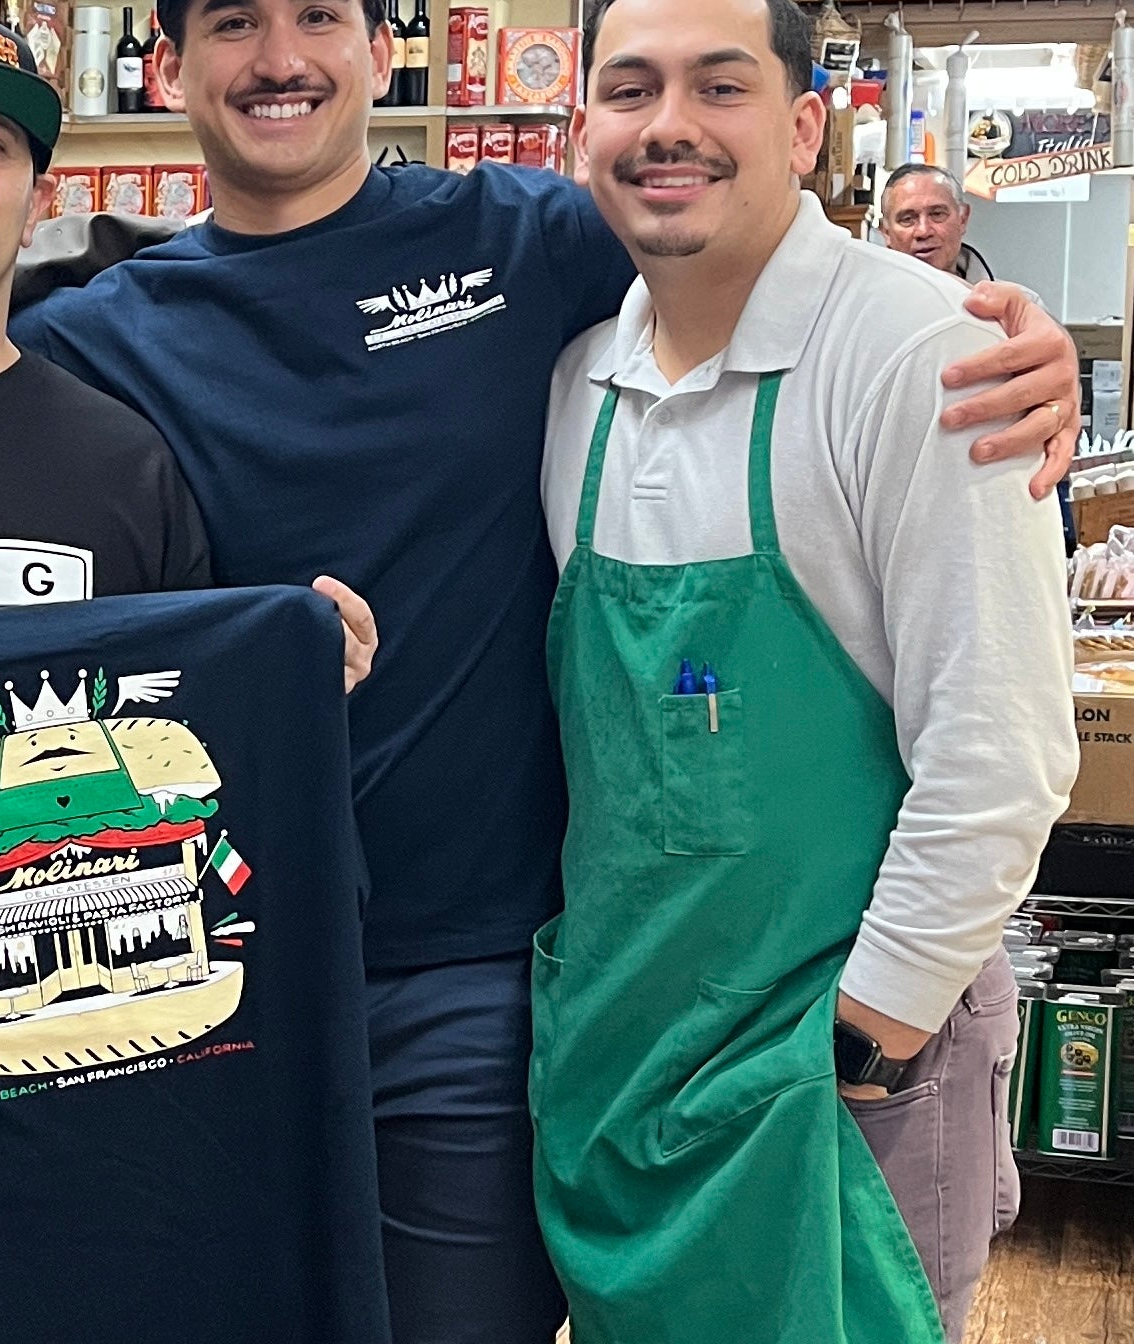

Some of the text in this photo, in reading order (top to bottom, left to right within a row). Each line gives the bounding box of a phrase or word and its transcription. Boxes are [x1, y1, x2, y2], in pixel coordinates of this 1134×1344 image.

[990, 149, 1111, 186] COLD DRINK
[1093, 731, 1133, 744] STACK
[24, 875, 132, 901] DELICATESSEN
[17, 915, 70, 933] RAVIOLI
[83, 905, 126, 922] PASTA
[127, 893, 191, 914] FACTORY
[0, 1081, 48, 1101] BEACH
[55, 1073, 86, 1090] SAN
[86, 1057, 167, 1083] FRANCISCO
[176, 1039, 257, 1065] CALIFORNIA
